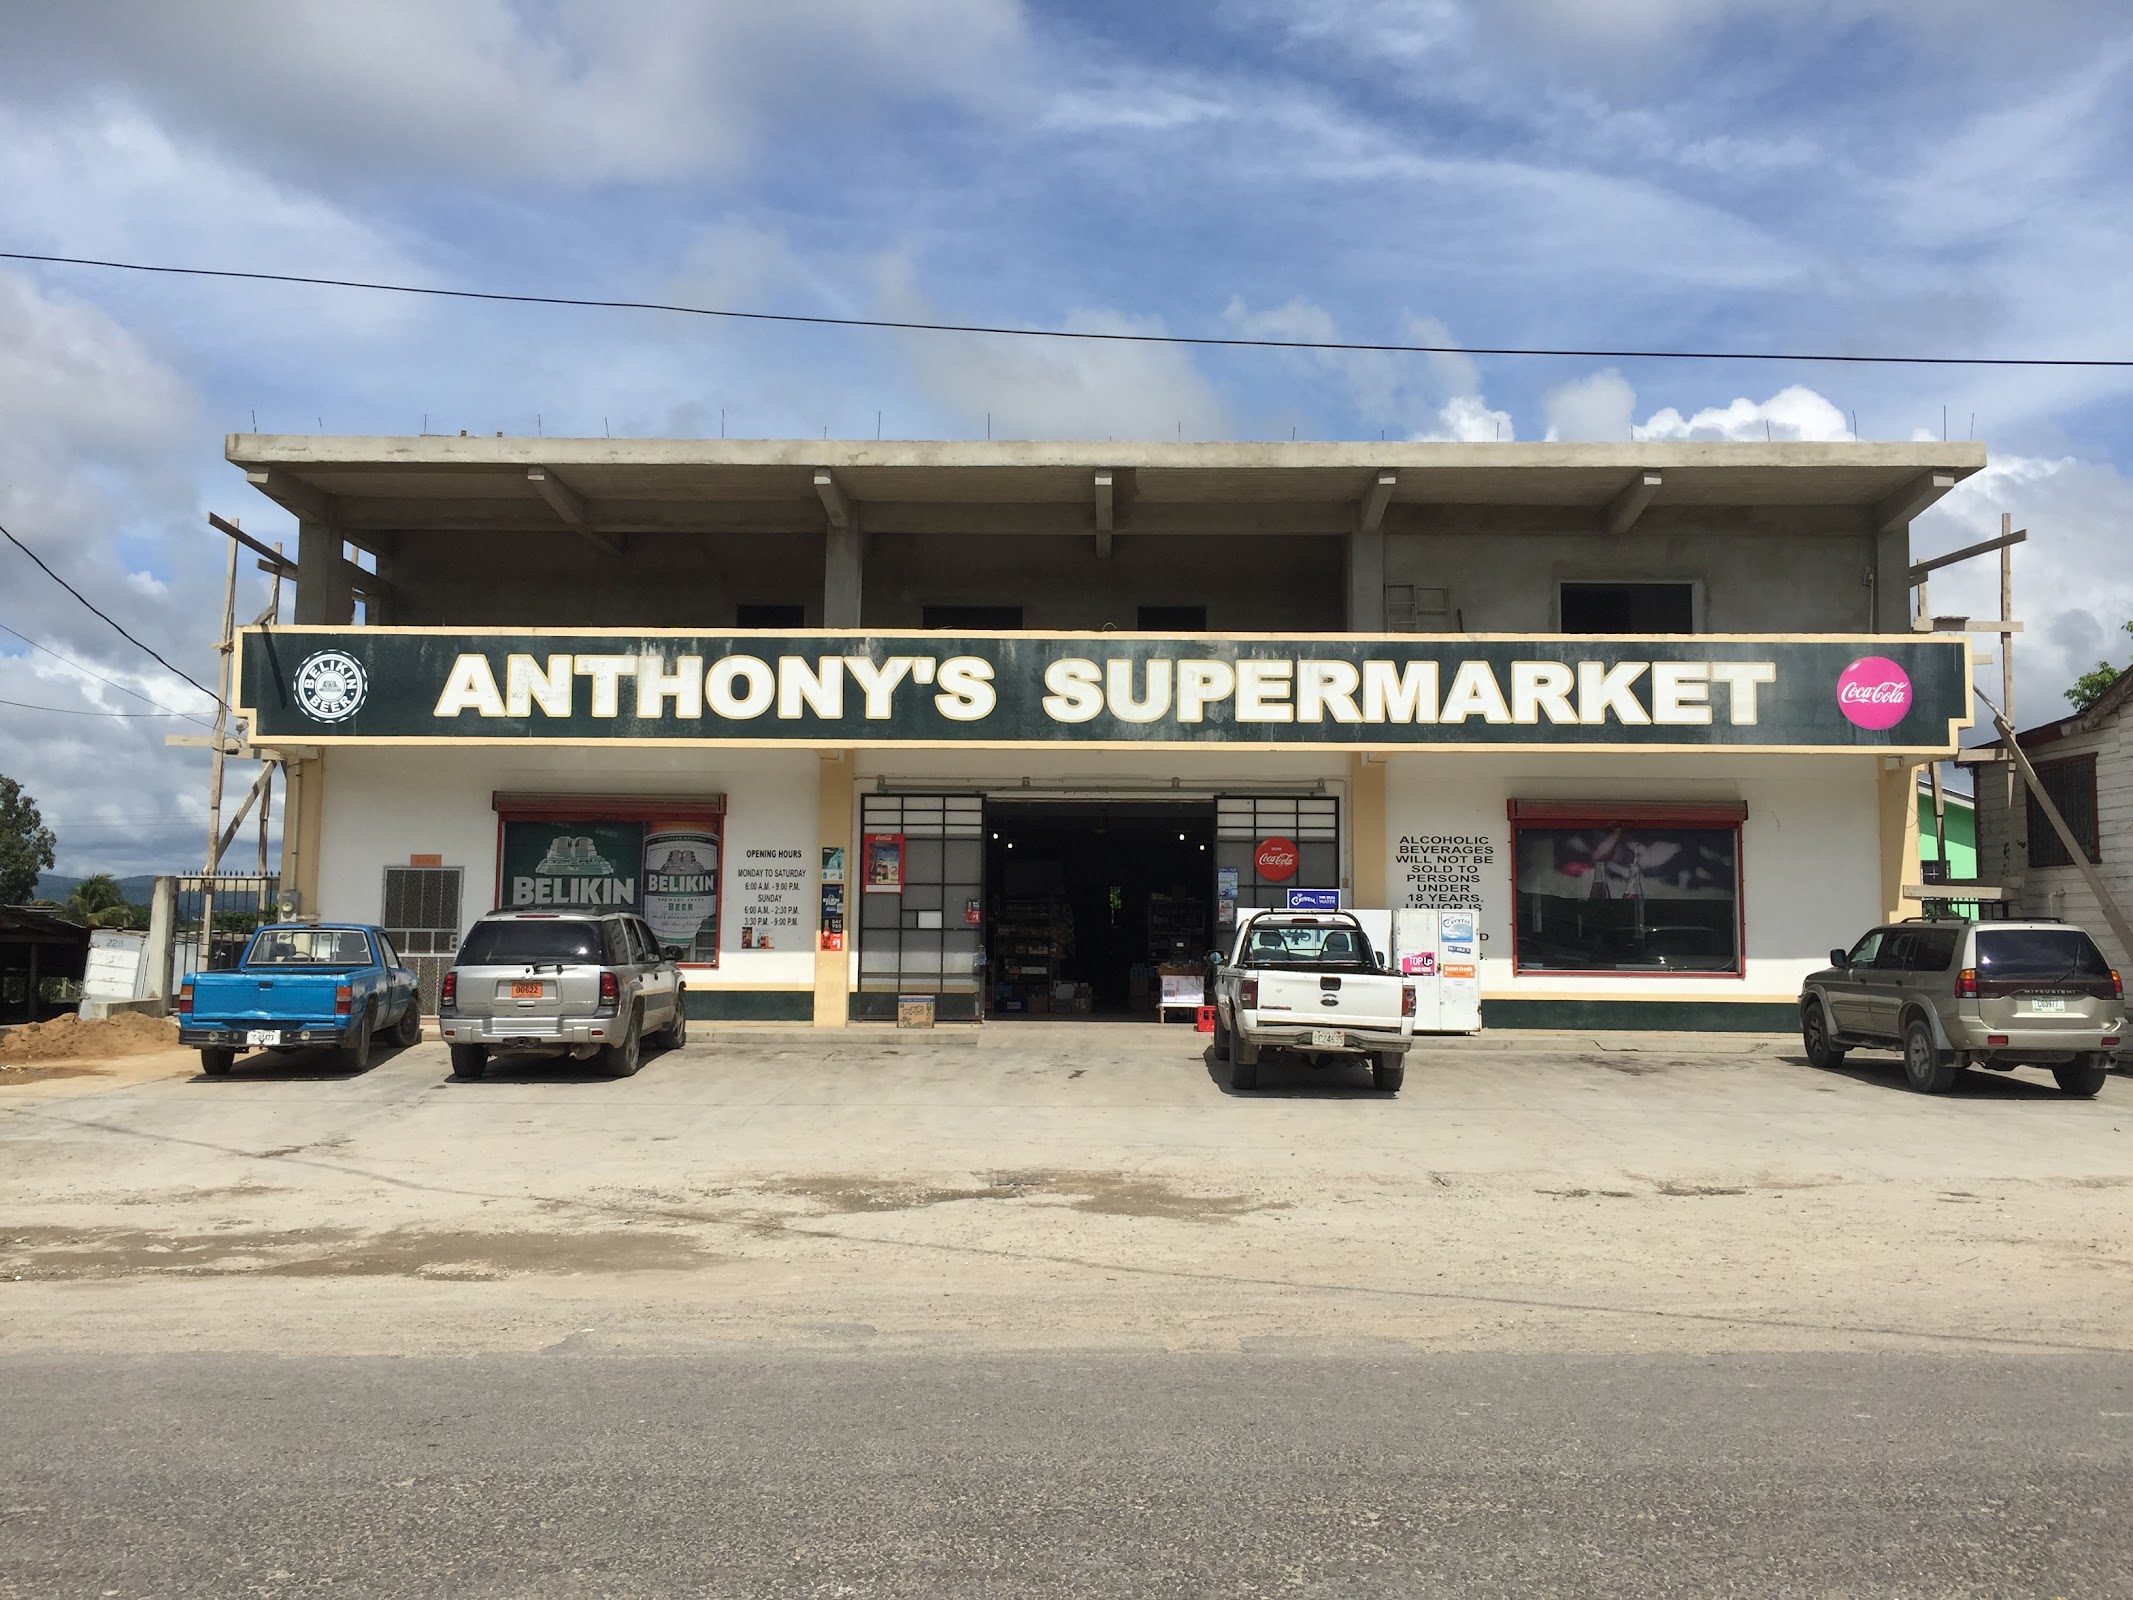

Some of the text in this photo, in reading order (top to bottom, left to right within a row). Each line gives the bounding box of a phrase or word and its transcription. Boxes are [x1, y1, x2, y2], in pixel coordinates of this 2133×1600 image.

[304, 660, 357, 689] BELIKIN
[434, 654, 1776, 724] ANTHONY'S SUPERMARKET
[309, 695, 352, 712] BEER
[1399, 836, 1489, 844] ALCOHOLIC
[746, 849, 802, 858] OPENING HOURS
[1399, 846, 1494, 854] BEVERAGES
[1395, 855, 1494, 864] WILL NOT BE
[738, 868, 807, 878] MONDAY TO SATURDAY
[1411, 865, 1478, 873] SOLD TO
[648, 873, 715, 893] BELIKIN
[1407, 874, 1480, 883] PERSONS
[512, 876, 635, 905] BELIKIN
[775, 882, 788, 890] 9:00
[1417, 884, 1470, 892] UNDER
[757, 893, 783, 902] SUNDAY
[1408, 893, 1484, 902] 18 YEARS.
[668, 902, 694, 911] BEER
[774, 905, 787, 914] 2:30
[744, 917, 757, 926] 3:30
[773, 917, 787, 926] 9:00
[1443, 918, 1471, 928] CRYSTAL
[1409, 956, 1423, 966] TOP
[516, 986, 539, 994] 00622
